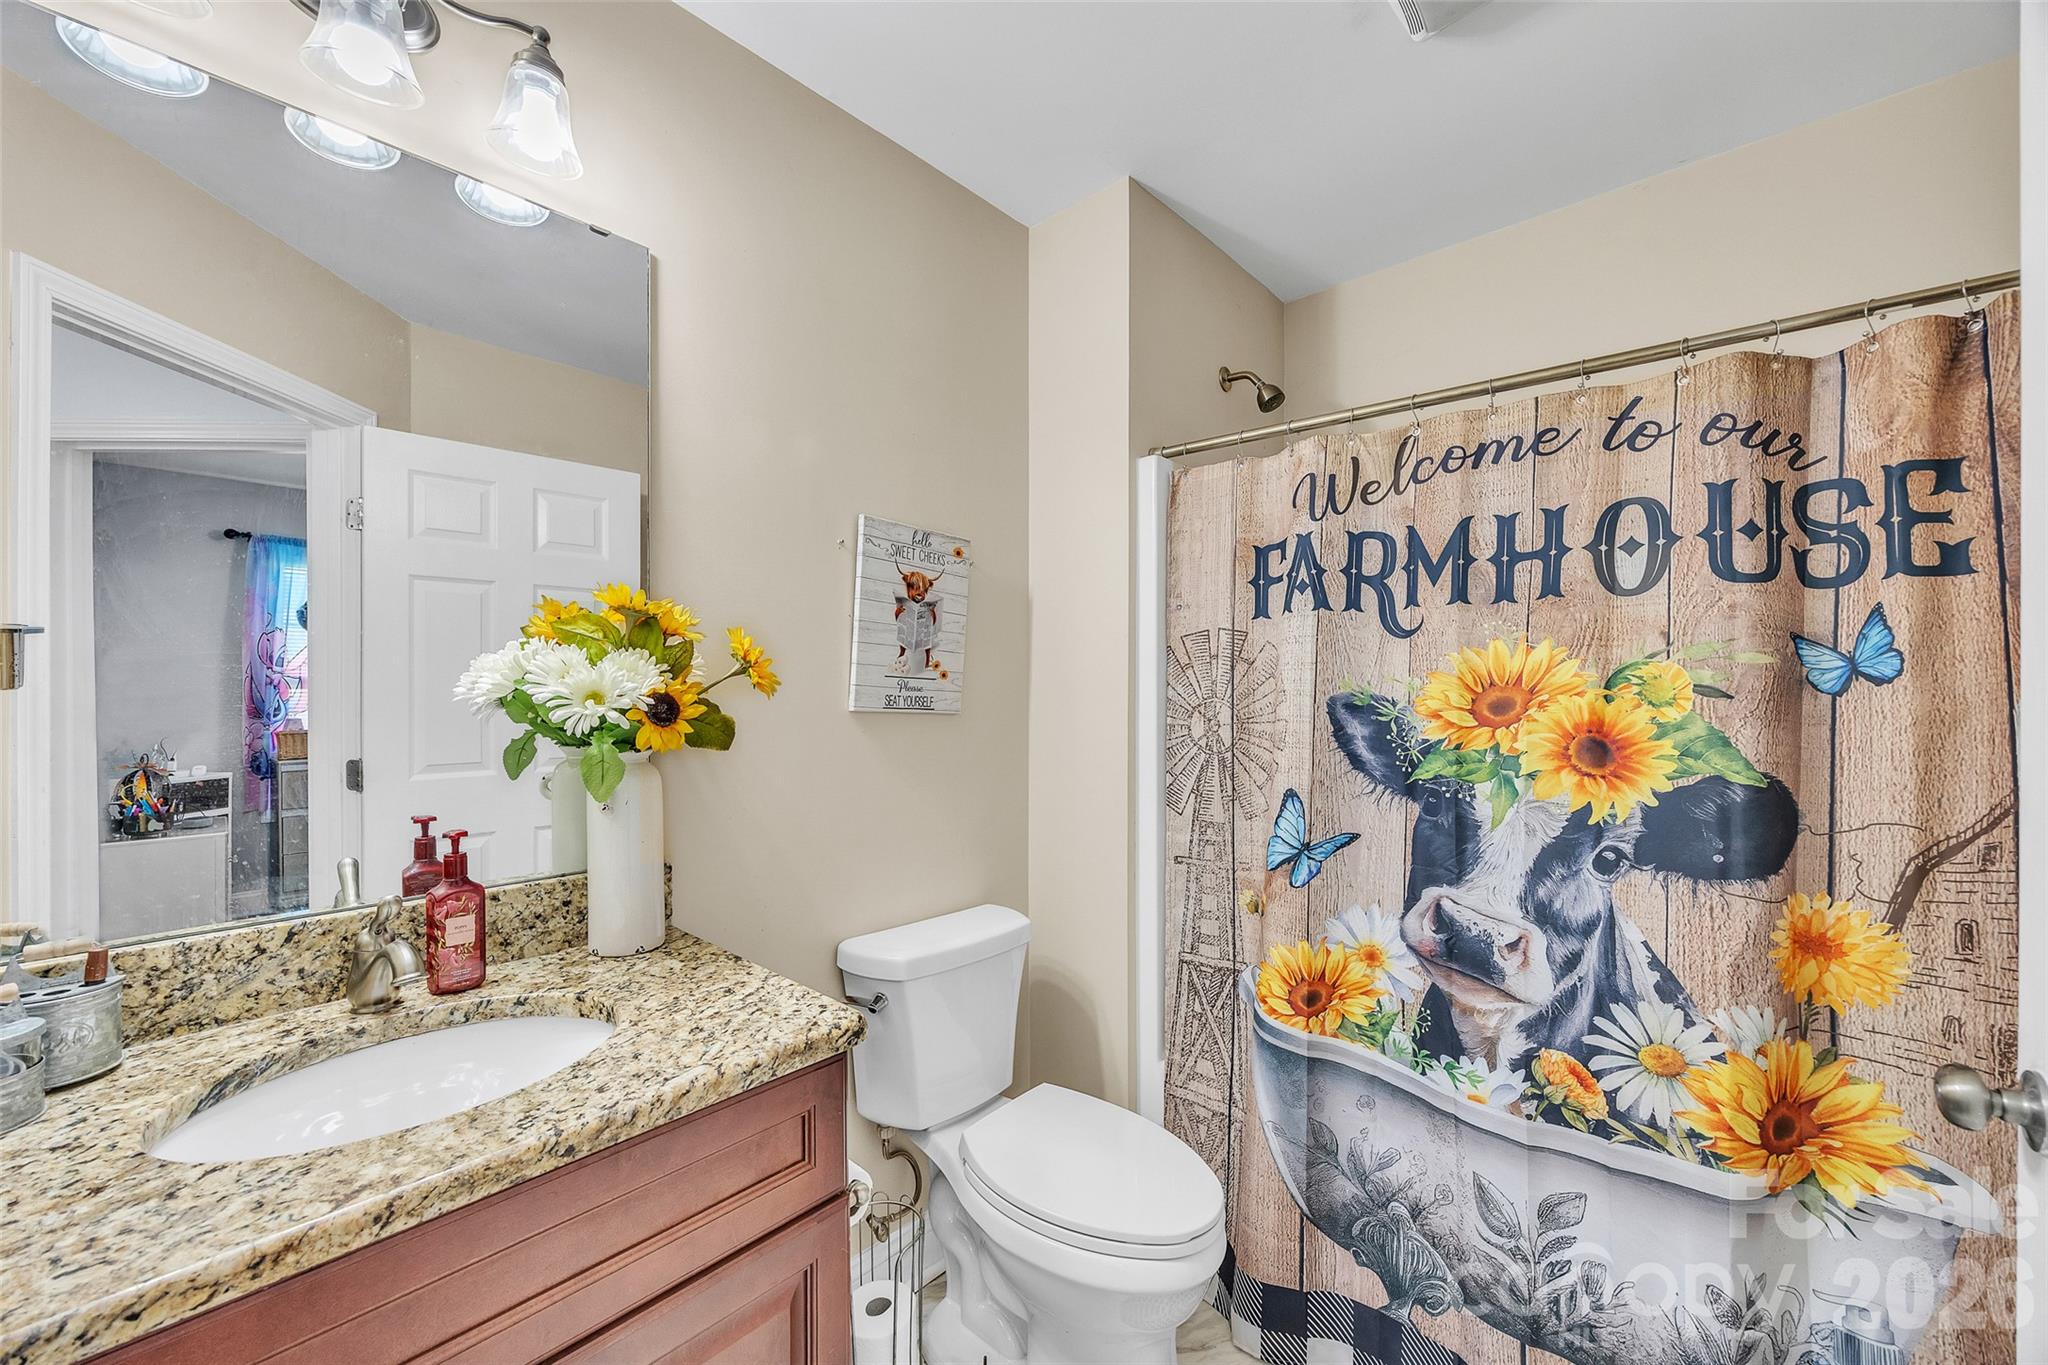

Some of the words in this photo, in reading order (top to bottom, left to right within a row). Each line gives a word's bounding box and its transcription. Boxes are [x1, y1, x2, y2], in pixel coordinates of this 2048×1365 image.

[1293, 426, 1582, 522] Welcome
[1602, 396, 1683, 453] to
[1700, 412, 1829, 471] our
[911, 529, 932, 547] hello
[1248, 455, 1980, 639] FARMHOUSE
[890, 544, 916, 561] SWEET
[919, 550, 946, 567] CHEEKS
[897, 679, 924, 693] Please
[884, 694, 901, 707] SEAT
[902, 695, 934, 708] YOURSELF
